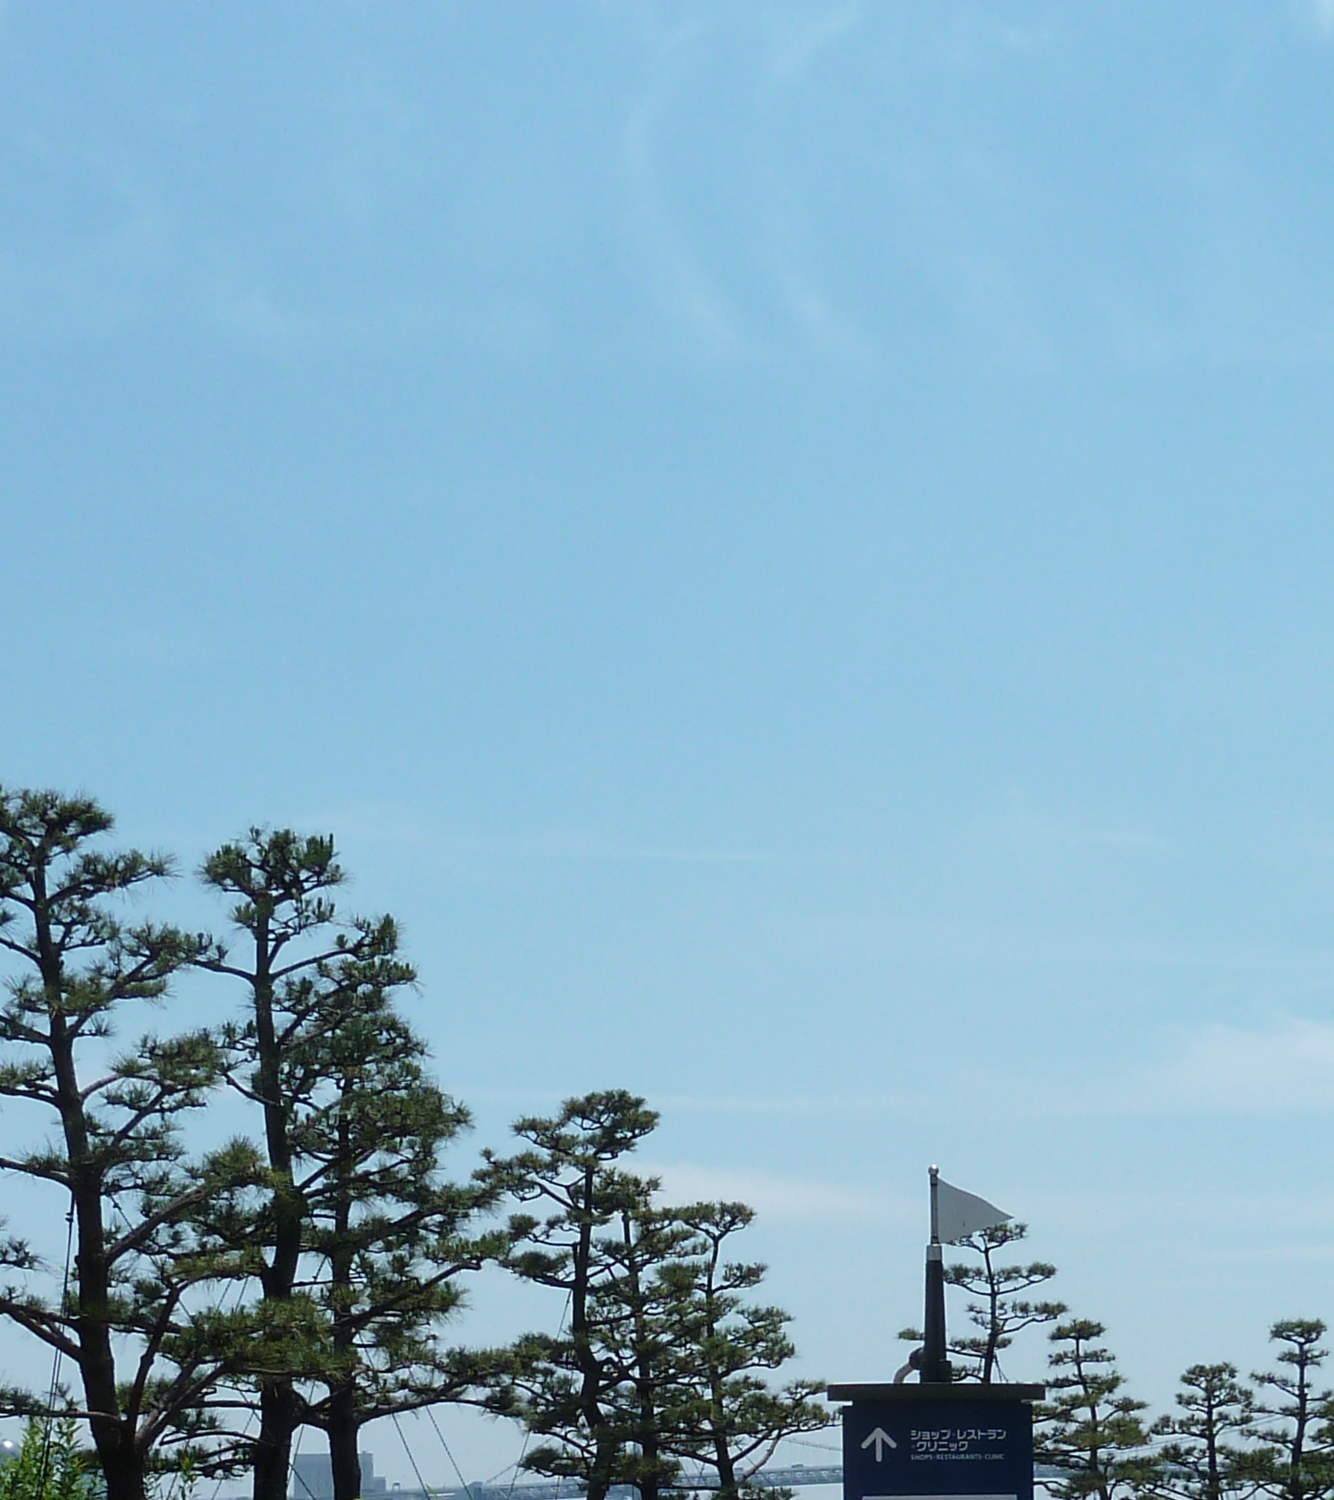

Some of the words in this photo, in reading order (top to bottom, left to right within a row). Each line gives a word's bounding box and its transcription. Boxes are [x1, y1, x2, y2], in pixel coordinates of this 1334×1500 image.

[910, 1429, 1006, 1440] ショップ・レストラン
